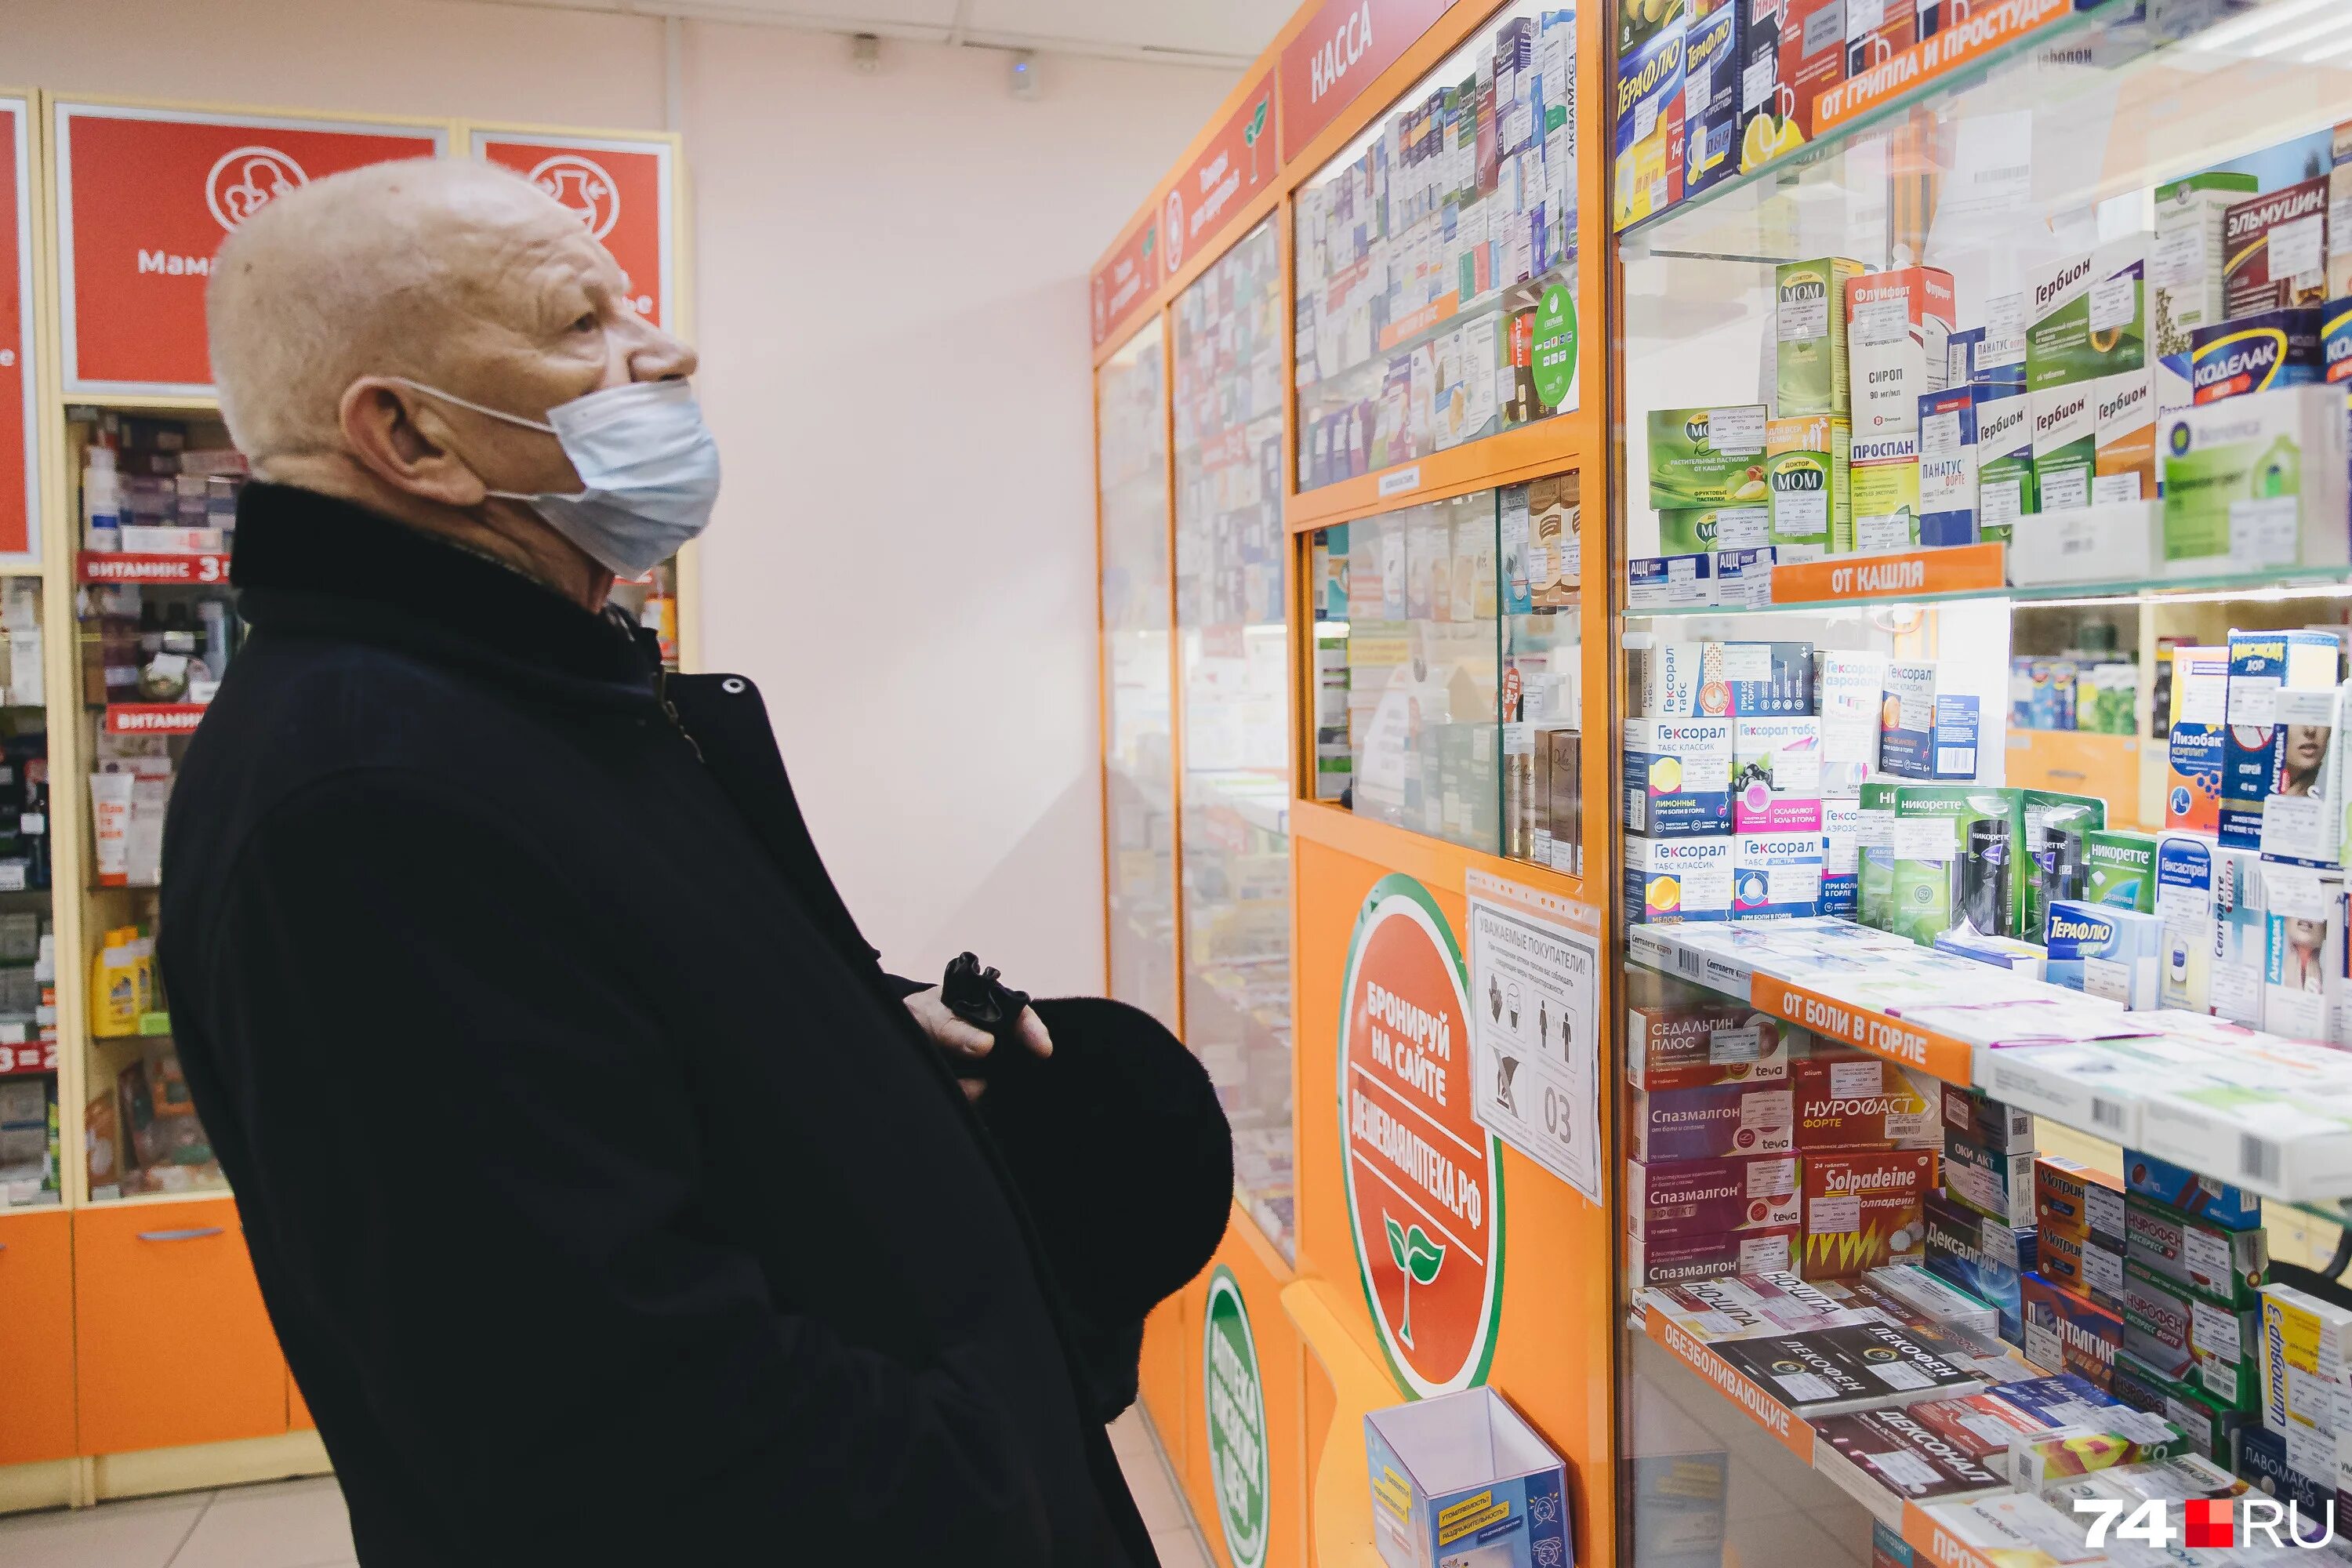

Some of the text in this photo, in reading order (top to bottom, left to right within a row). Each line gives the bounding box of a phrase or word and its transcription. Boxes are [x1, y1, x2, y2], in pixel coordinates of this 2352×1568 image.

[1310, 1, 1372, 103] КАССА
[1617, 38, 1679, 121] ТЕРАФЛЮ
[1821, 90, 1842, 120] ОТ
[1846, 53, 1918, 109] ГРИППА
[1923, 41, 1939, 71] И
[2035, 258, 2091, 306] Гербион
[1785, 285, 1820, 303] МОМ
[1978, 339, 2008, 355] ПАНАТУС
[1868, 368, 1903, 384] СИРОП
[2194, 343, 2275, 387] КОДЕЛАК
[2099, 386, 2147, 420] Гербион
[1980, 409, 2024, 441] Гербион
[2036, 398, 2085, 431] Гербион
[1853, 440, 1914, 459] ПРОСПАН
[1922, 459, 1962, 479] ПАНАТУС
[1777, 471, 1817, 491] МОМ
[1945, 474, 1965, 487] ФОРТЕ
[1631, 561, 1649, 577] АЦЦ
[1719, 551, 1739, 570] АЦЦ
[1831, 561, 1925, 593] ОТ КАШЛЯ
[1663, 648, 1678, 713] Гексорал
[1888, 664, 1932, 683] Гексорал
[1679, 682, 1687, 713] табс
[1658, 725, 1725, 742] Гексорал
[1740, 724, 1817, 738] Гексорал табс
[1655, 799, 1696, 808] ЛИМОННЫЕ
[1901, 800, 1962, 811] никоретте
[1827, 810, 1857, 821] Гексо
[1655, 844, 1726, 860] Гексорал
[1744, 840, 1814, 858] Гексорал
[2092, 844, 2149, 865] никоретте
[2161, 857, 2209, 878] Гексаспрей
[2214, 876, 2225, 958] Септолете
[2051, 916, 2111, 941] ТЕРАФЛЮ
[1479, 916, 1586, 975] УВАЖАЕМЫЕ ПОКУПАТЕЛИ!
[1706, 958, 1735, 976] Септолете
[1551, 971, 1573, 987] соблюдать
[1367, 980, 1450, 1062] БРОНИРУЙ
[1652, 1018, 1733, 1036] СЕДАЛЬГИН
[1782, 992, 1927, 1065] ОТ БОЛИ В ГОРЛЕ
[1651, 1036, 1695, 1051] ПЛЮС
[1371, 1025, 1446, 1107] НА САЙТЕ
[1755, 1065, 1783, 1077] teva
[1543, 1086, 1572, 1144] 03
[1652, 1107, 1740, 1123] Спазмалгон
[1803, 1098, 1915, 1117] НУРОФАСТ
[1803, 1118, 1842, 1129] ФОРТЕ
[1762, 1139, 1789, 1149] teva
[1955, 1143, 1994, 1170] ОКИ АКТ
[1825, 1166, 1916, 1196] Solpadeine
[2040, 1167, 2085, 1200] Мотрин
[1650, 1186, 1738, 1205] Спазмалгон
[1773, 1211, 1798, 1222] teva
[2128, 1212, 2184, 1248] НУРОФЕН
[1926, 1221, 1999, 1275] Дексалгин
[2128, 1231, 2165, 1254] ЭКСПРЕСС
[1649, 1261, 1737, 1279] Спазмалгон
[2125, 1312, 2157, 1334] ЭКСПРЕСС
[2126, 1289, 2183, 1335] НУРОФЕН
[2157, 1330, 2180, 1346] ФОРТЕ
[1868, 1327, 1958, 1377] ЛЕКОФЕН
[1780, 1340, 1867, 1393] ЛЕКОФЕН
[2266, 1302, 2287, 1428] Цитовир-3
[1664, 1323, 1791, 1438] ОБЕЗБОЛИВАЮЩИЕ
[1875, 1410, 1996, 1482] ДЕКСОНАЛ
[2245, 1446, 2315, 1496] ЛАВОМАКС
[2291, 1487, 2315, 1508] НЕО
[1442, 1496, 1490, 1523] УТОМЛЯЕМОСТЬ?
[1442, 1506, 1507, 1541] РАЗДРАЖИТЕЛЬНОСТЬ?
